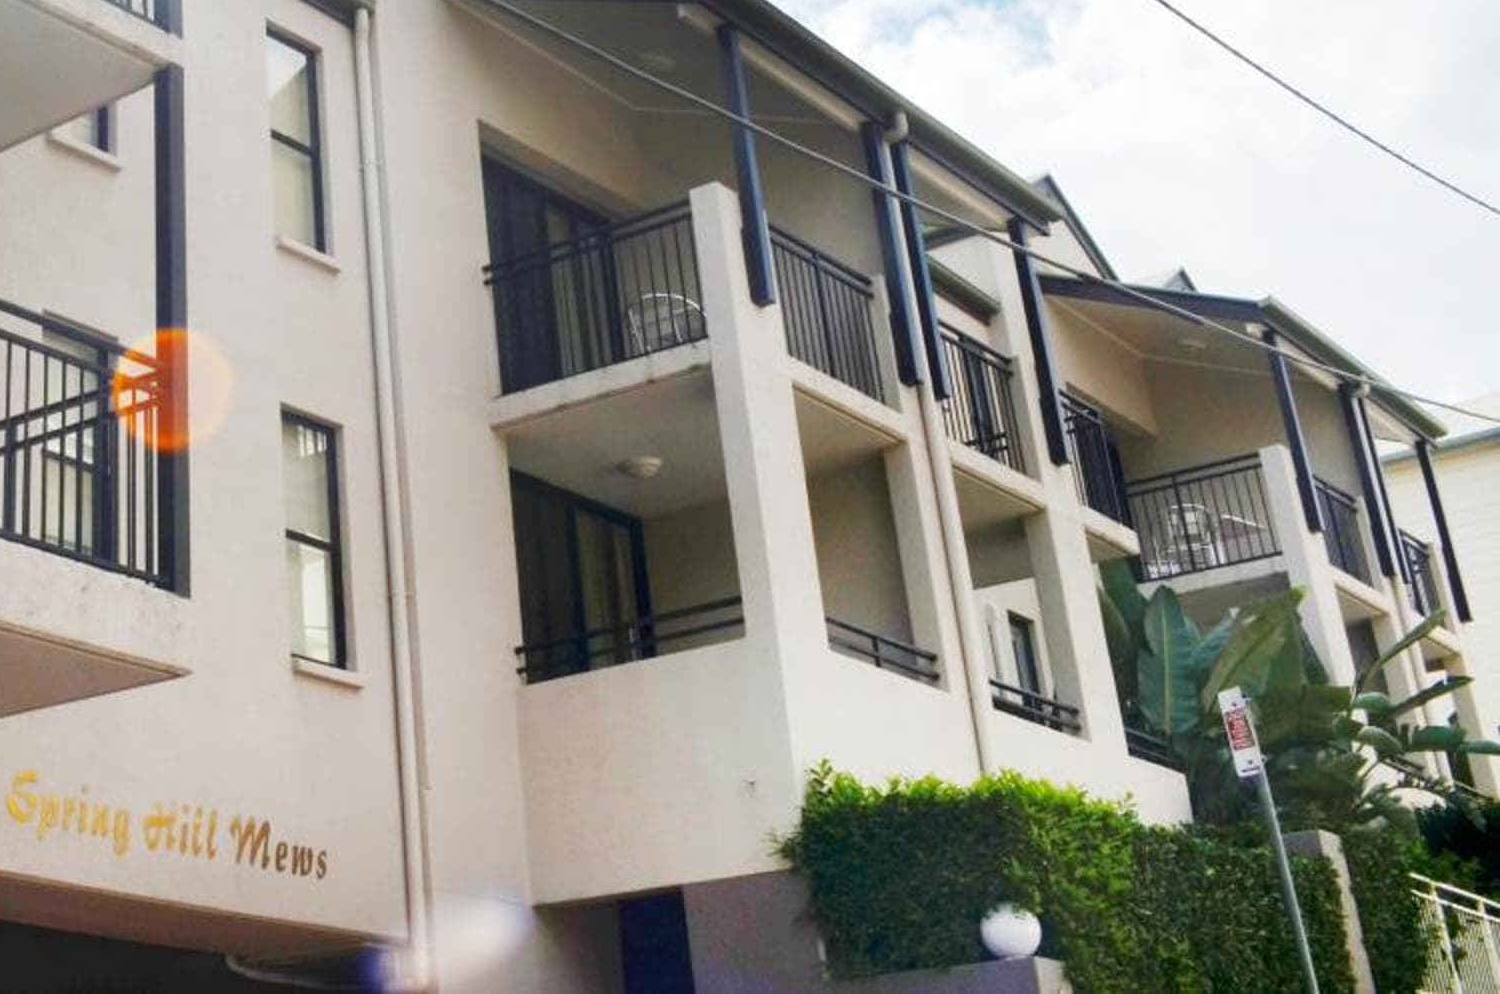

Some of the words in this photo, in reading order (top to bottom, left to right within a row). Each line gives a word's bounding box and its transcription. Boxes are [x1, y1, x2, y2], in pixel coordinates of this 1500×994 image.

[5, 770, 131, 858] Spring
[142, 802, 218, 861] Hill
[229, 813, 328, 881] Mews
